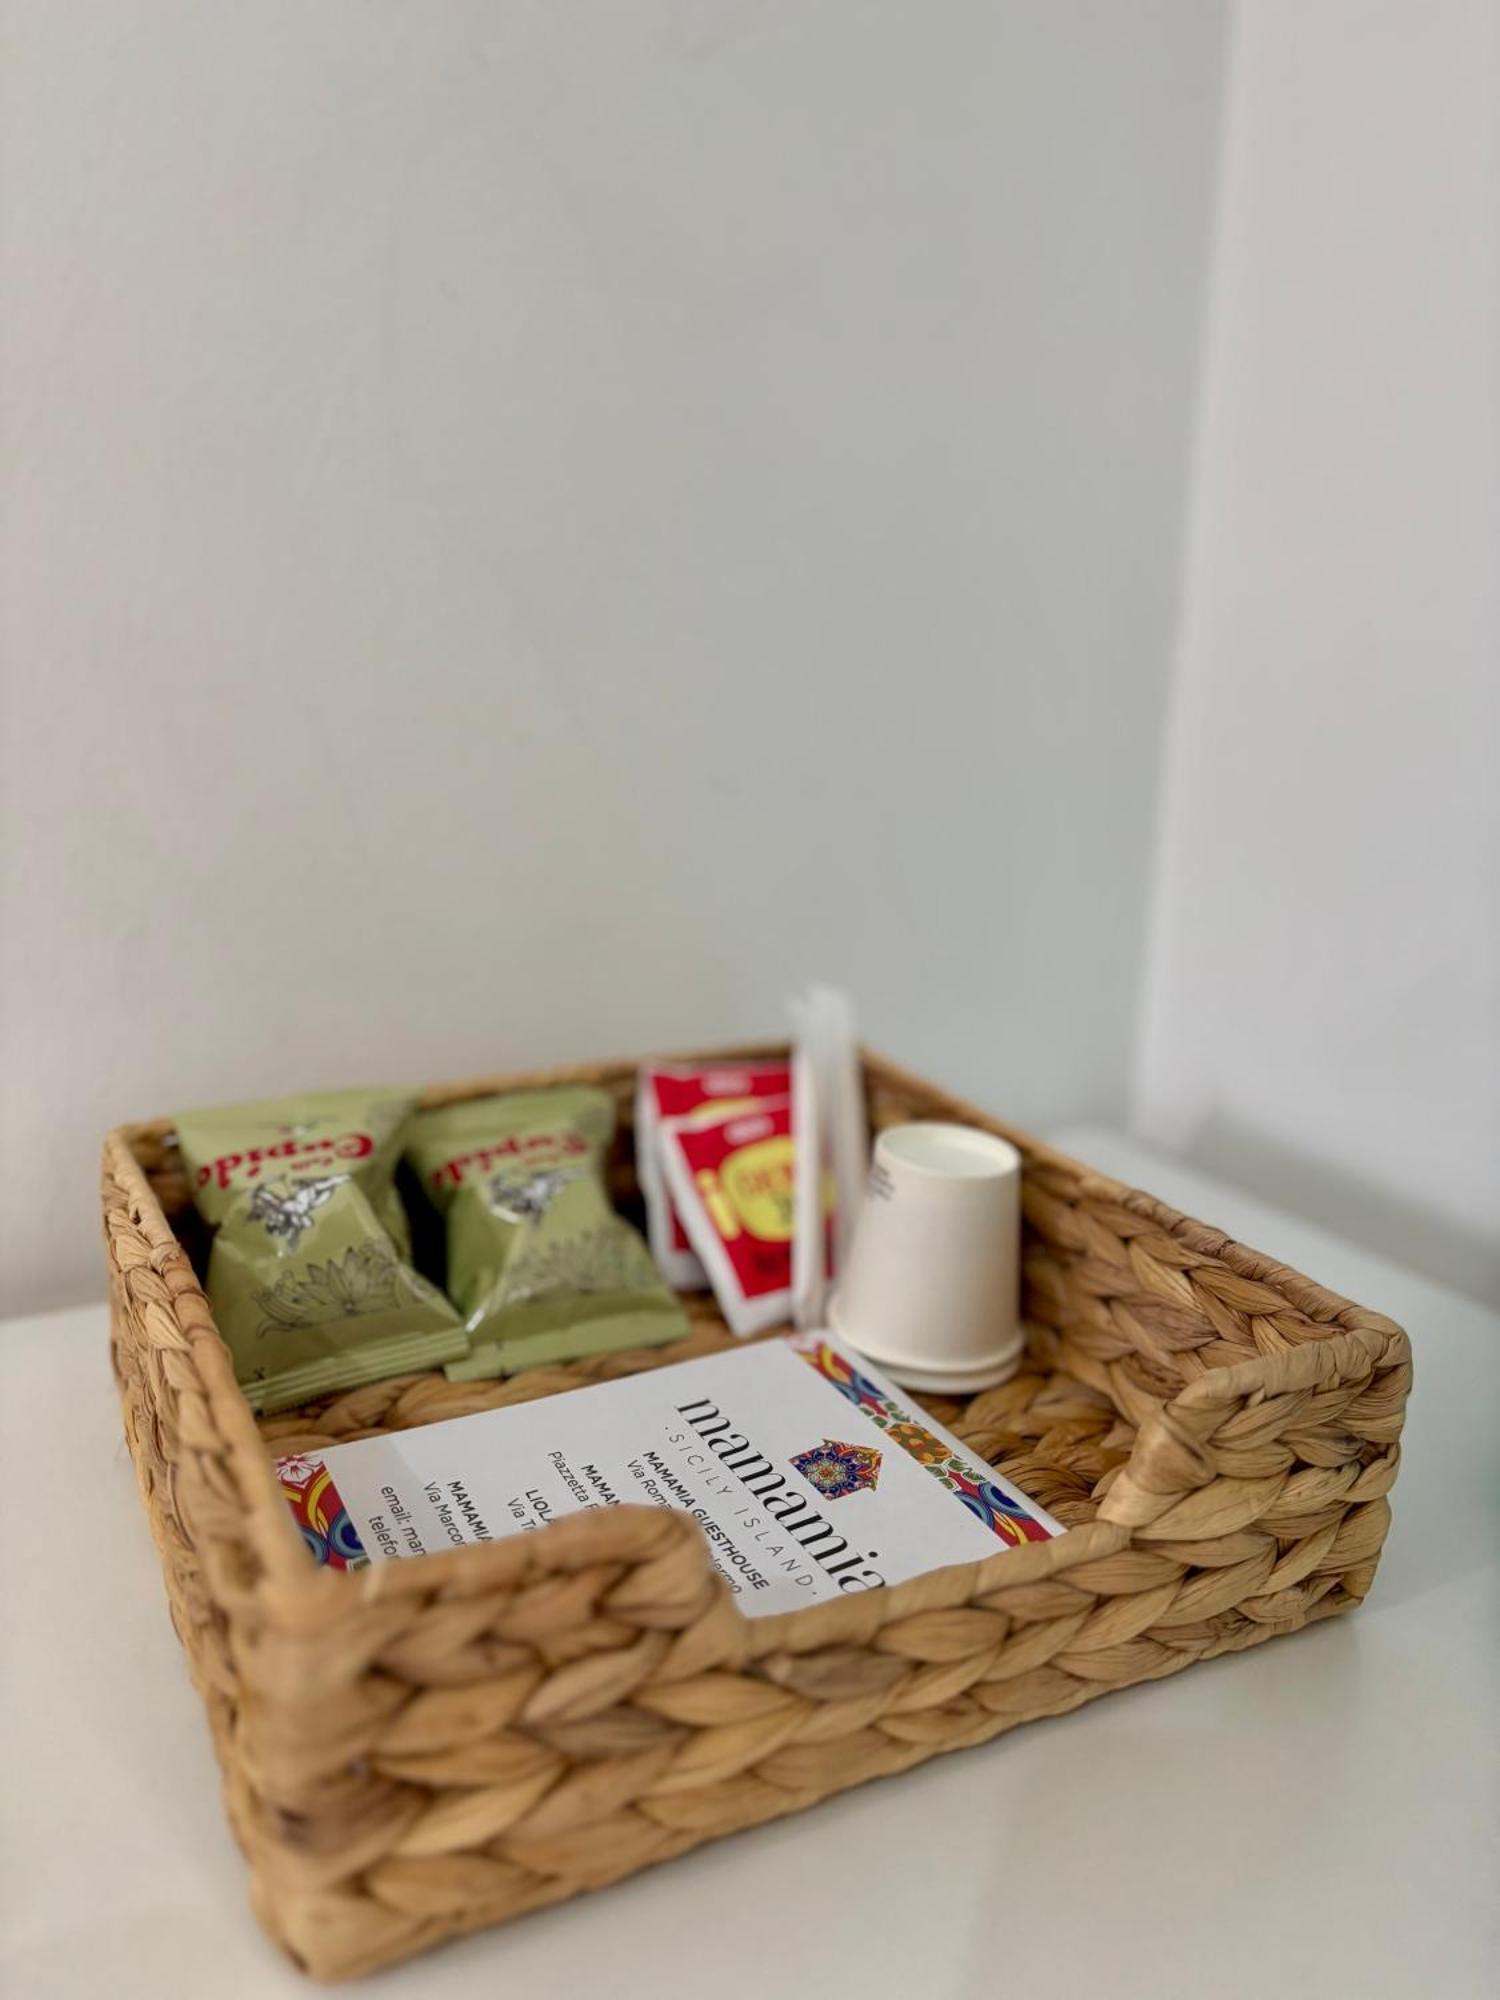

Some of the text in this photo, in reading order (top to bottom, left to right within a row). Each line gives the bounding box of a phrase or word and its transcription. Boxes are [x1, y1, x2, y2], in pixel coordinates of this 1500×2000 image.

[548, 1451, 589, 1502] Piazzetta
[627, 1459, 645, 1479] Via
[381, 1485, 412, 1525] email:
[424, 1481, 442, 1503] Via
[507, 1498, 525, 1518] Via
[674, 1398, 886, 1593] mamamia
[643, 1451, 770, 1590] MAMAMIA GUESTHOUSE
